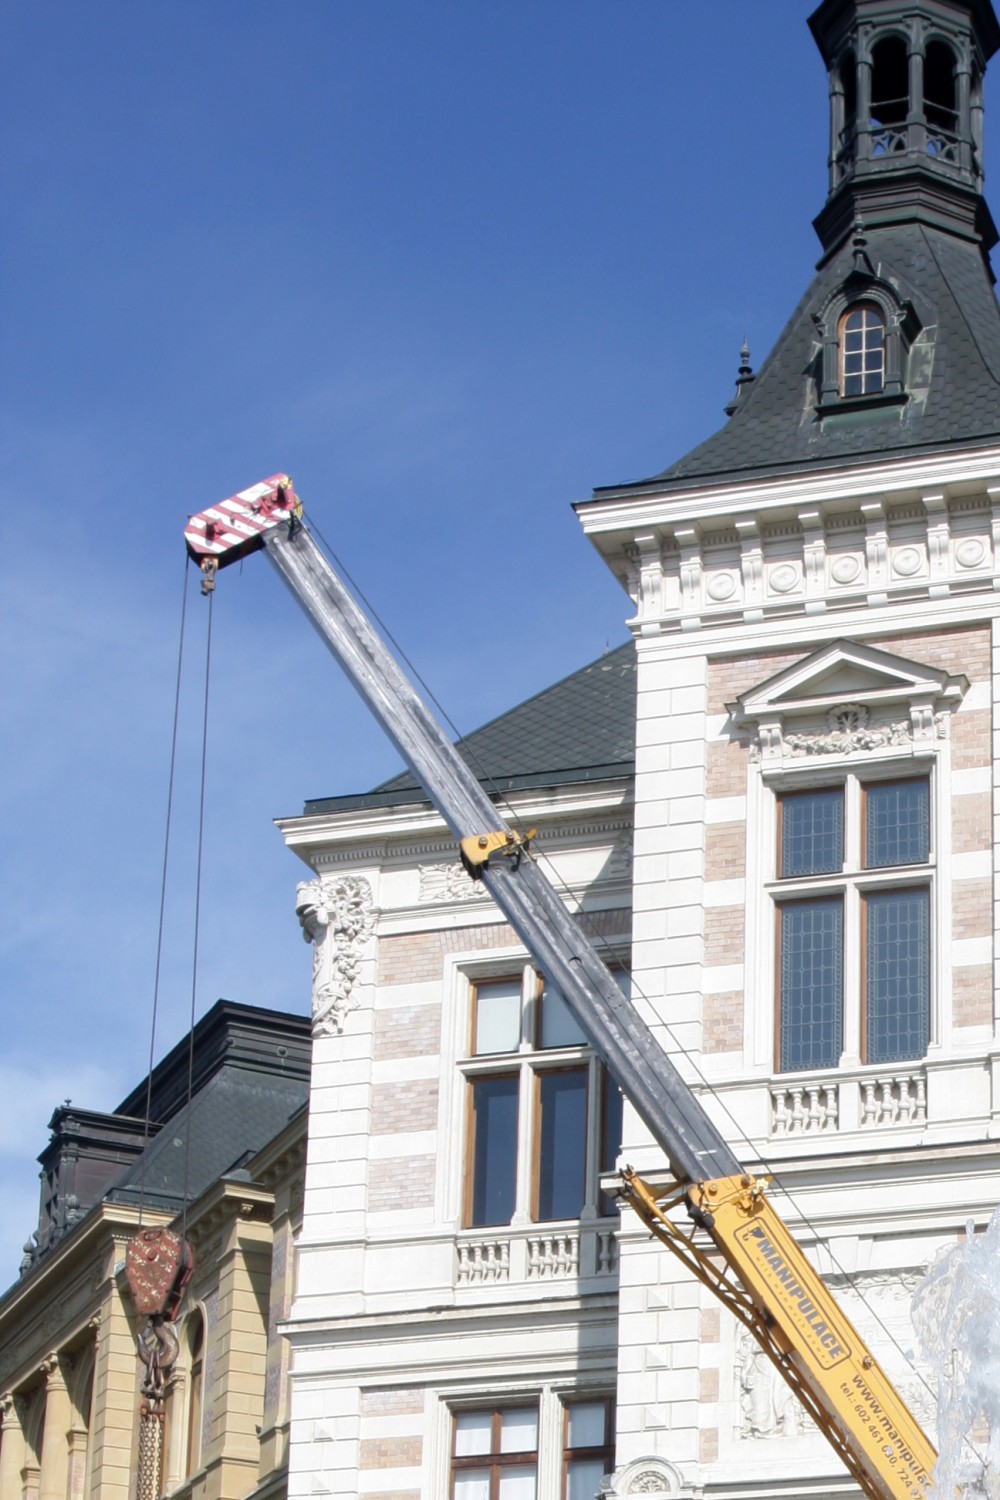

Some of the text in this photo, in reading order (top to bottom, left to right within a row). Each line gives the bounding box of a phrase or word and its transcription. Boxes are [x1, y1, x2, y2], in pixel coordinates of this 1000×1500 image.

[756, 1238, 845, 1360] MANIPULACE
[840, 1382, 857, 1404] tel.:
[854, 1404, 871, 1424] 602
[868, 1425, 884, 1445] 461
[897, 1468, 913, 1488] 724
[852, 1374, 932, 1489] www.manipulac
